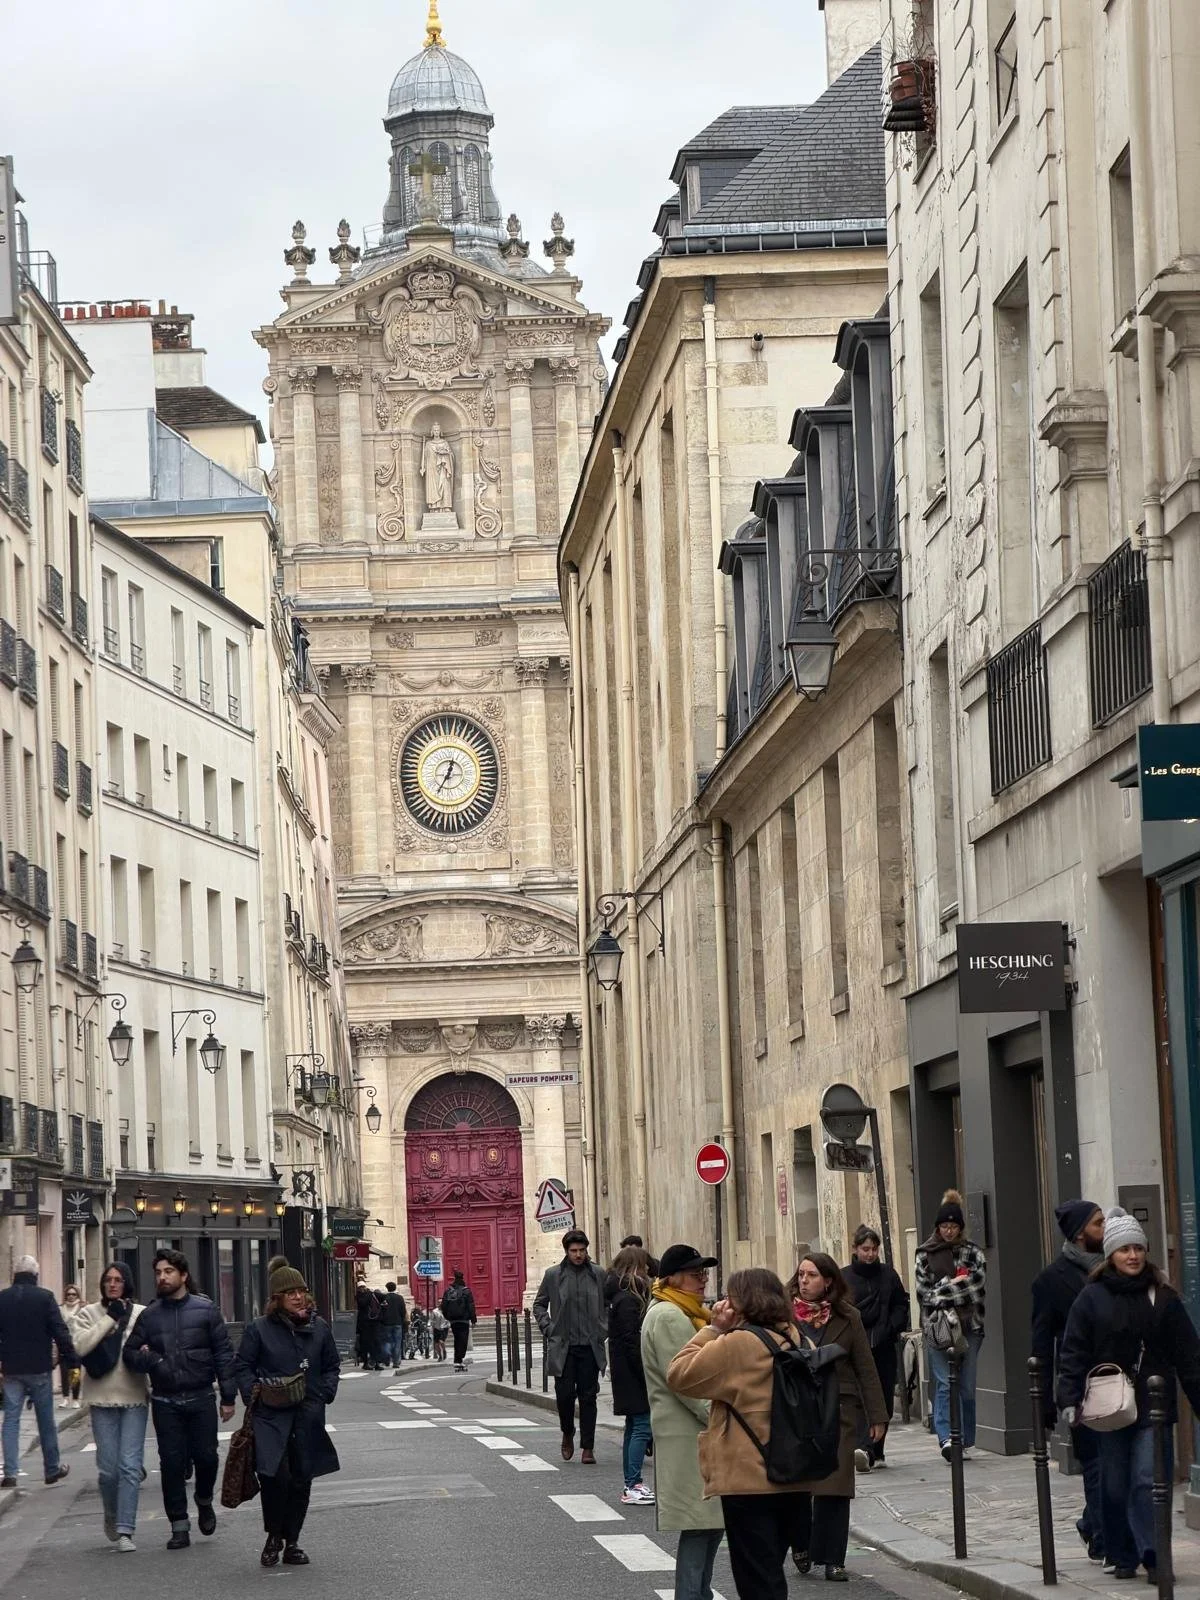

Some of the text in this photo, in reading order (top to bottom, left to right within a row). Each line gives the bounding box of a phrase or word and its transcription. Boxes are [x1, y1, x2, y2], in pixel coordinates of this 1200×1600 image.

[1150, 766, 1168, 776] Les
[969, 954, 1054, 970] HESCHUNG
[995, 970, 1030, 989] 1934
[508, 1074, 574, 1084] SAPEURS POMPIERS
